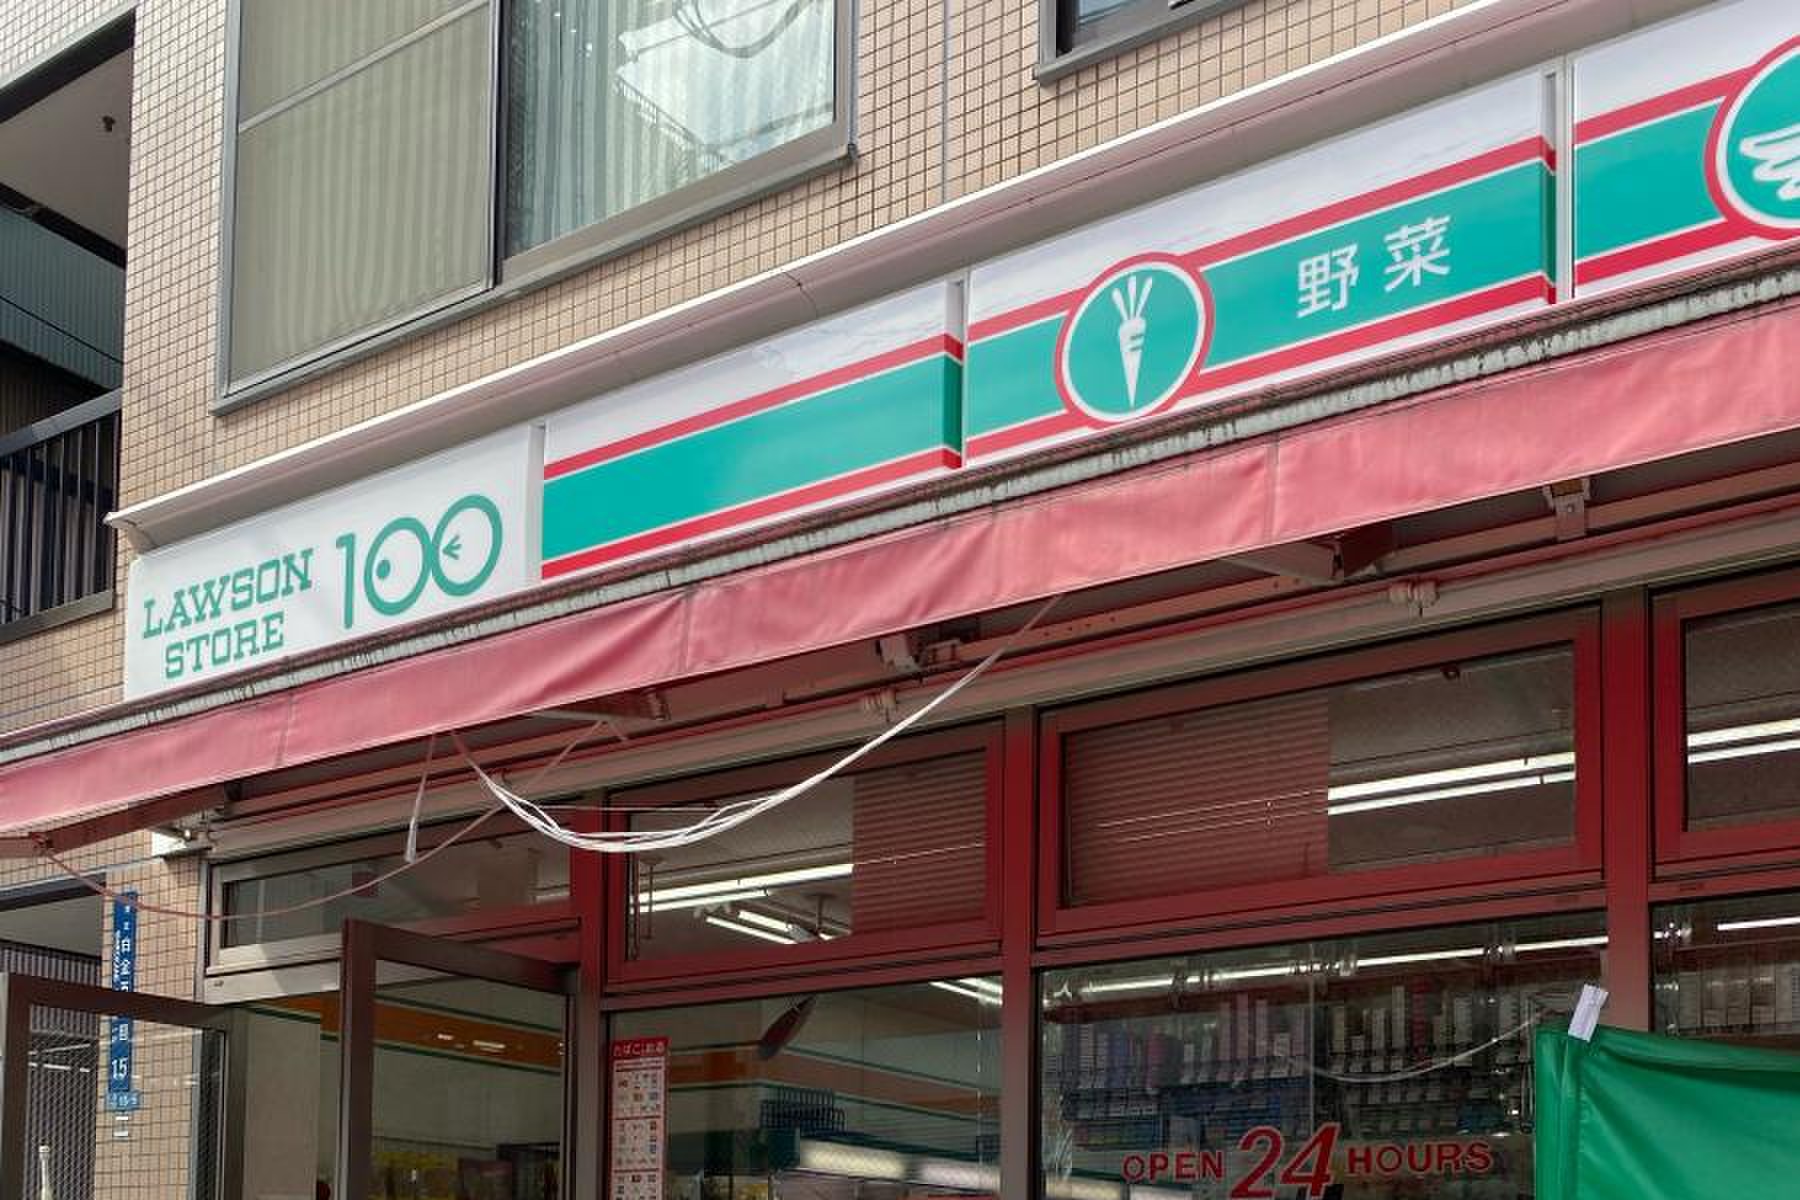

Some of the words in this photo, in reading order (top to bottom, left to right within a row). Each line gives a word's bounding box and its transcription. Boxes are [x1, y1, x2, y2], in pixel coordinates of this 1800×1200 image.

[1297, 215, 1450, 318] 野菜
[142, 548, 315, 639] LAWSON
[335, 494, 503, 630] 100
[164, 611, 286, 680] STORE
[1121, 1150, 1226, 1184] OPEN
[1346, 1139, 1494, 1178] HOURS
